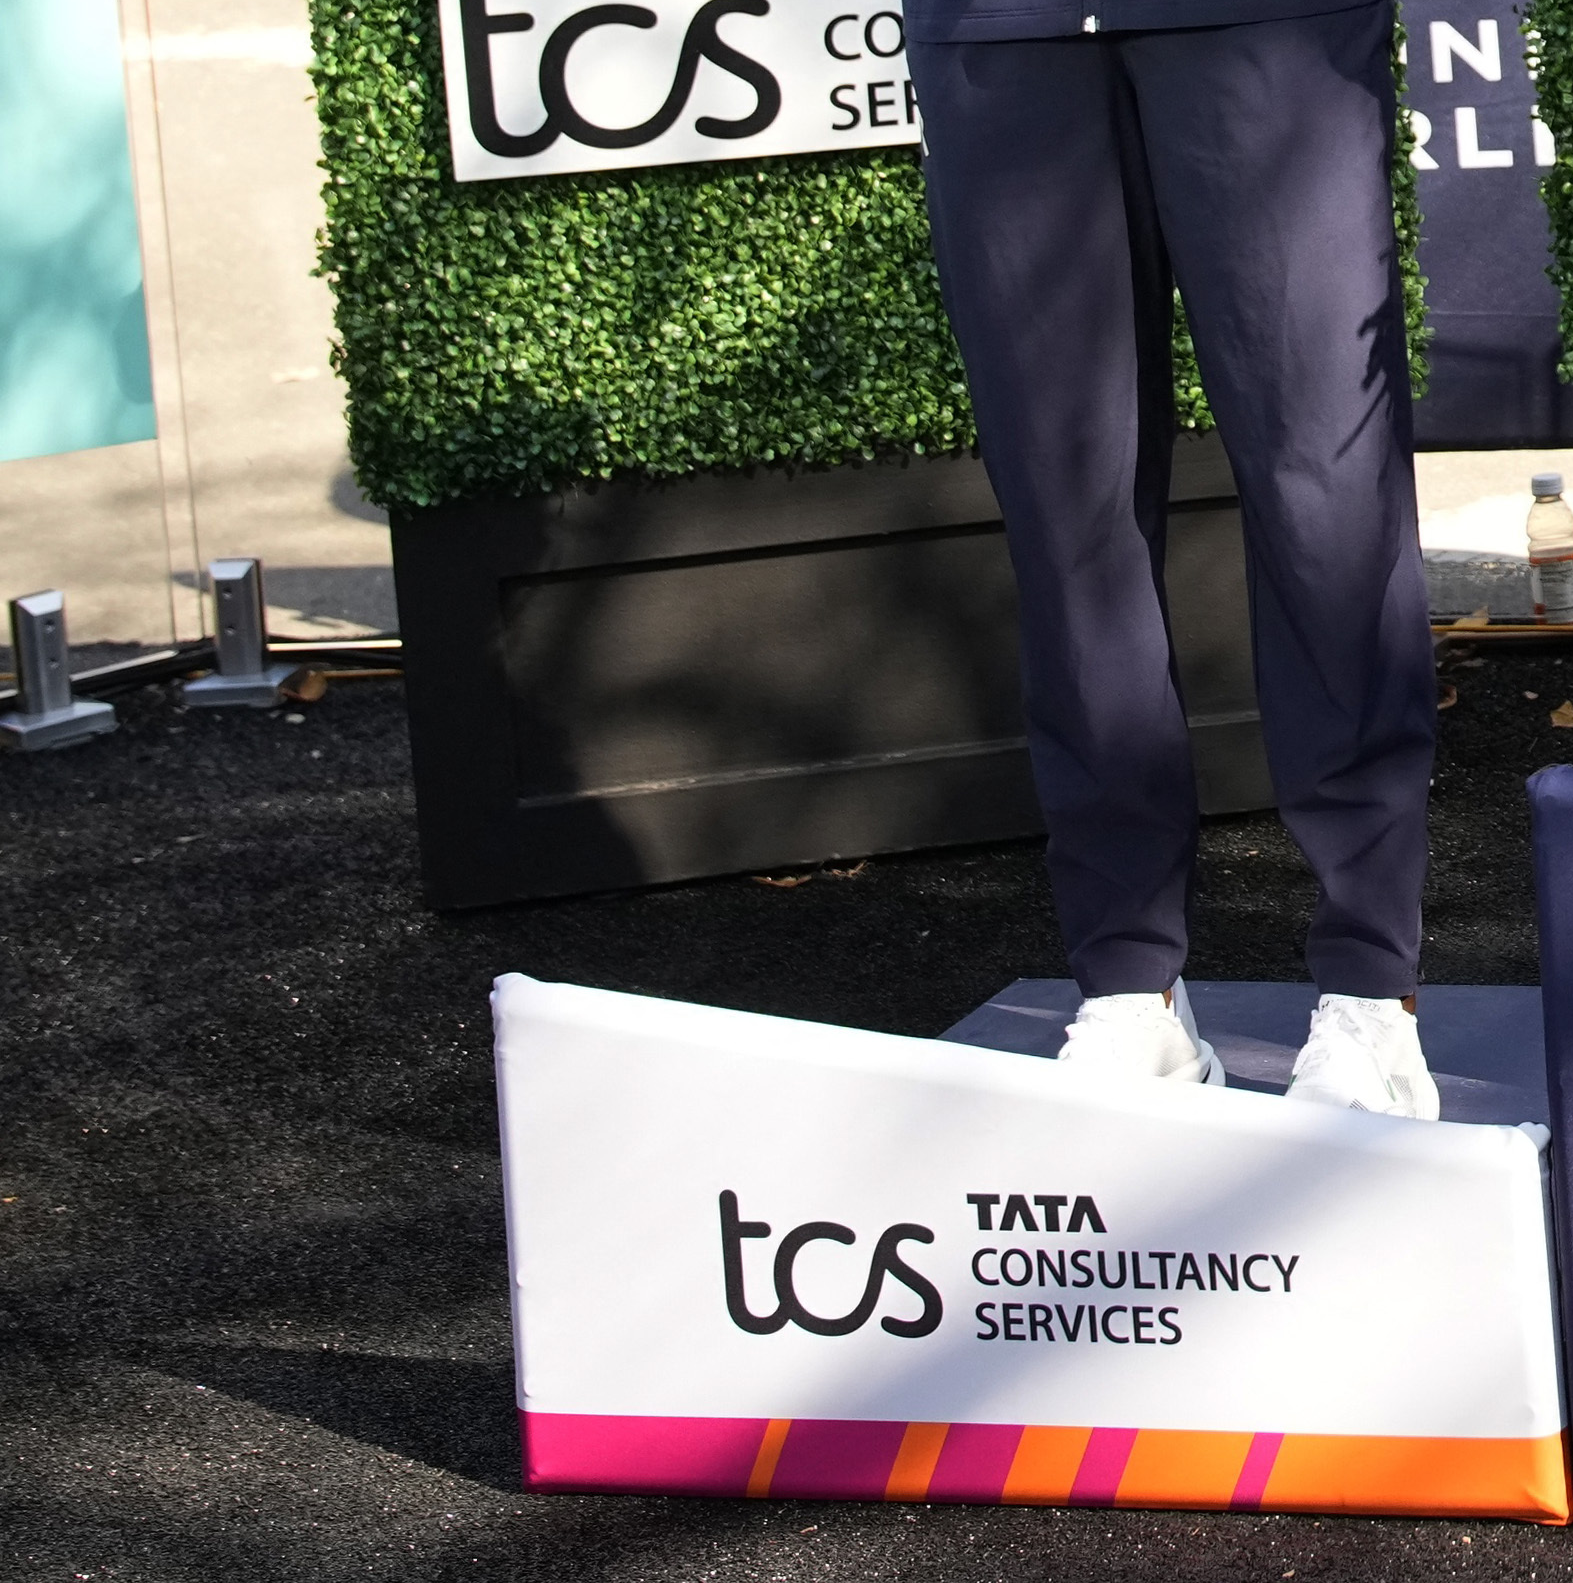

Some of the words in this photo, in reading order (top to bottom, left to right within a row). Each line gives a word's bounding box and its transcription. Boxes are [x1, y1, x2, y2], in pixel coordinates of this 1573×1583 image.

[966, 1193, 1107, 1234] TATA
[716, 1189, 945, 1340] tcs
[971, 1247, 1300, 1295] CONSULTANCY
[974, 1300, 1183, 1346] SERVICES
